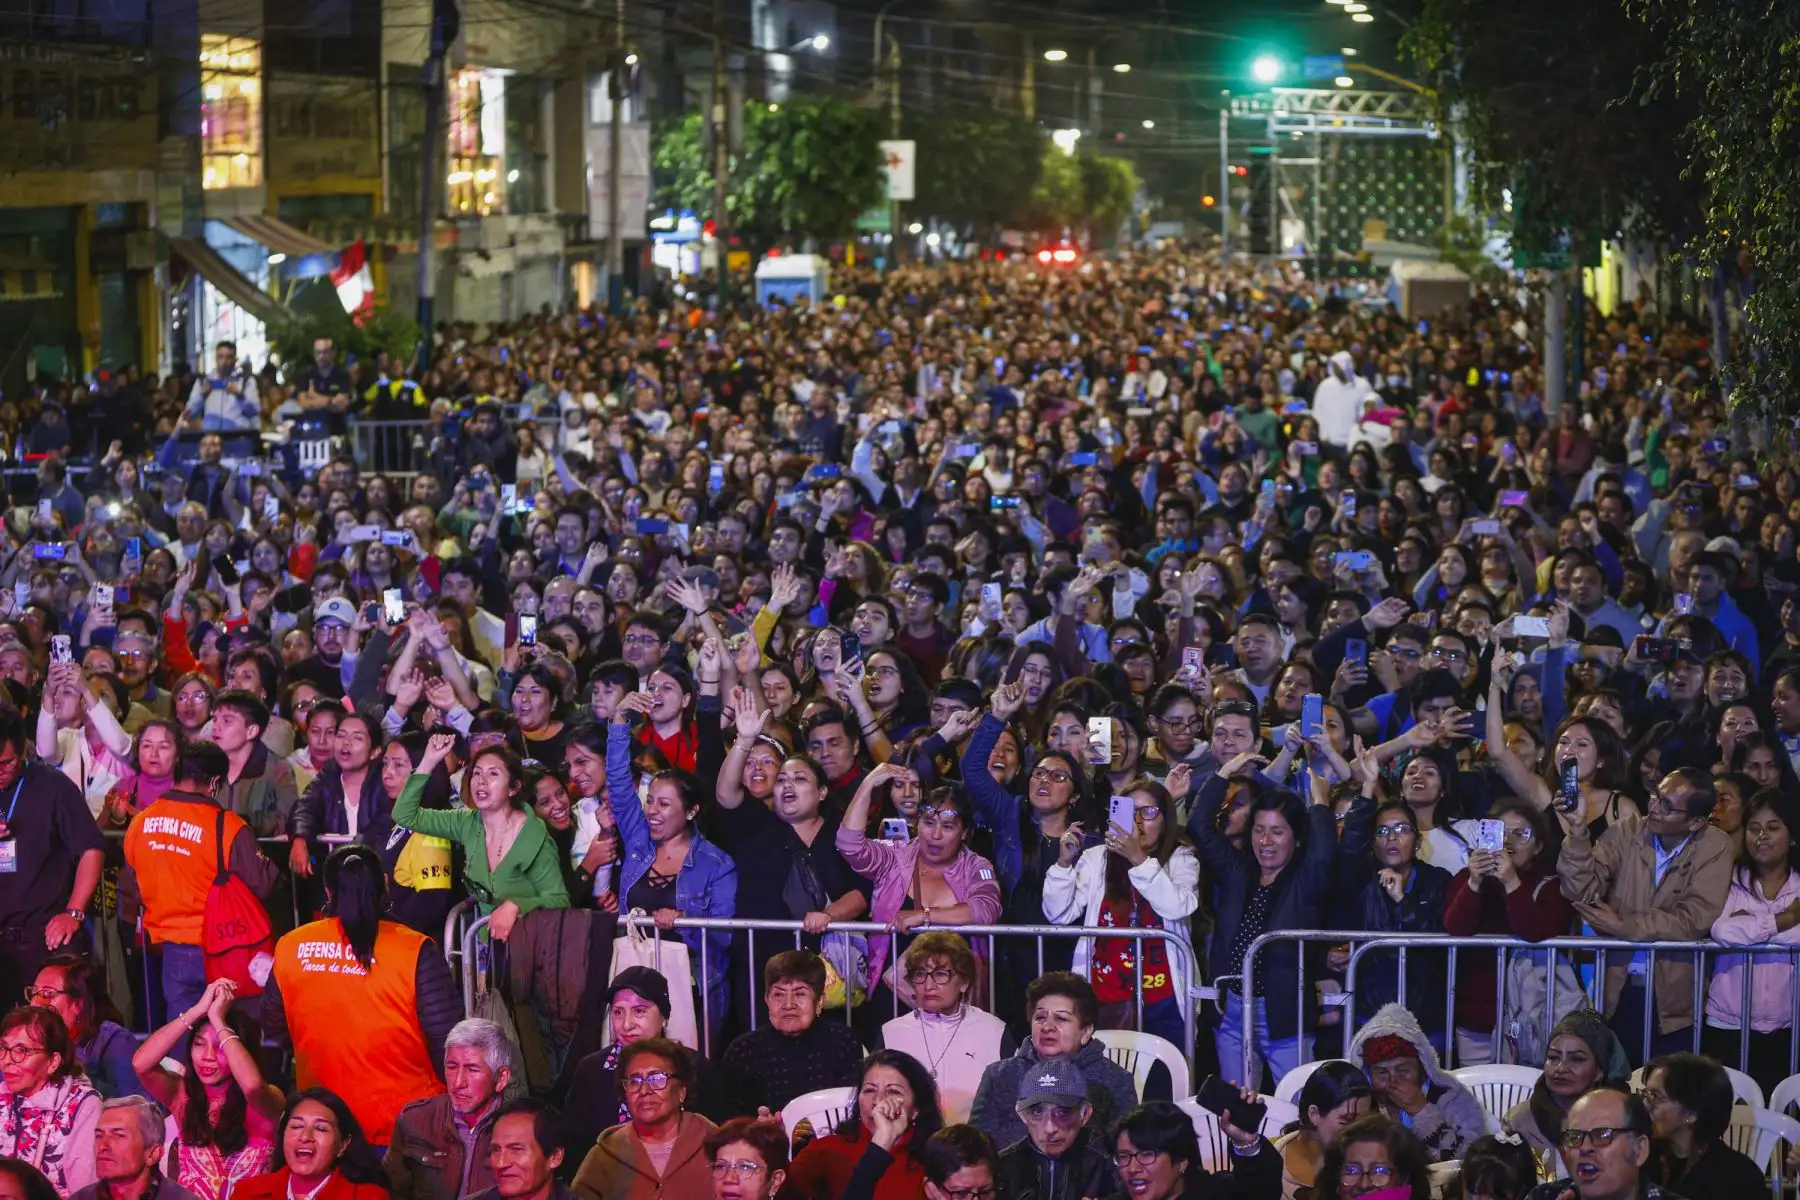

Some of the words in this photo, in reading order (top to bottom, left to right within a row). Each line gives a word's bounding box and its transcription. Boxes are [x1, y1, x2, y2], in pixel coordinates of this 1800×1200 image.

[143, 817, 178, 836] DEFENSA
[180, 821, 203, 844] CIVIL
[297, 941, 342, 958] DEFENSA
[301, 958, 326, 972] Tarea
[328, 961, 340, 972] de
[342, 963, 368, 976] todos
[1142, 973, 1166, 989] 28
